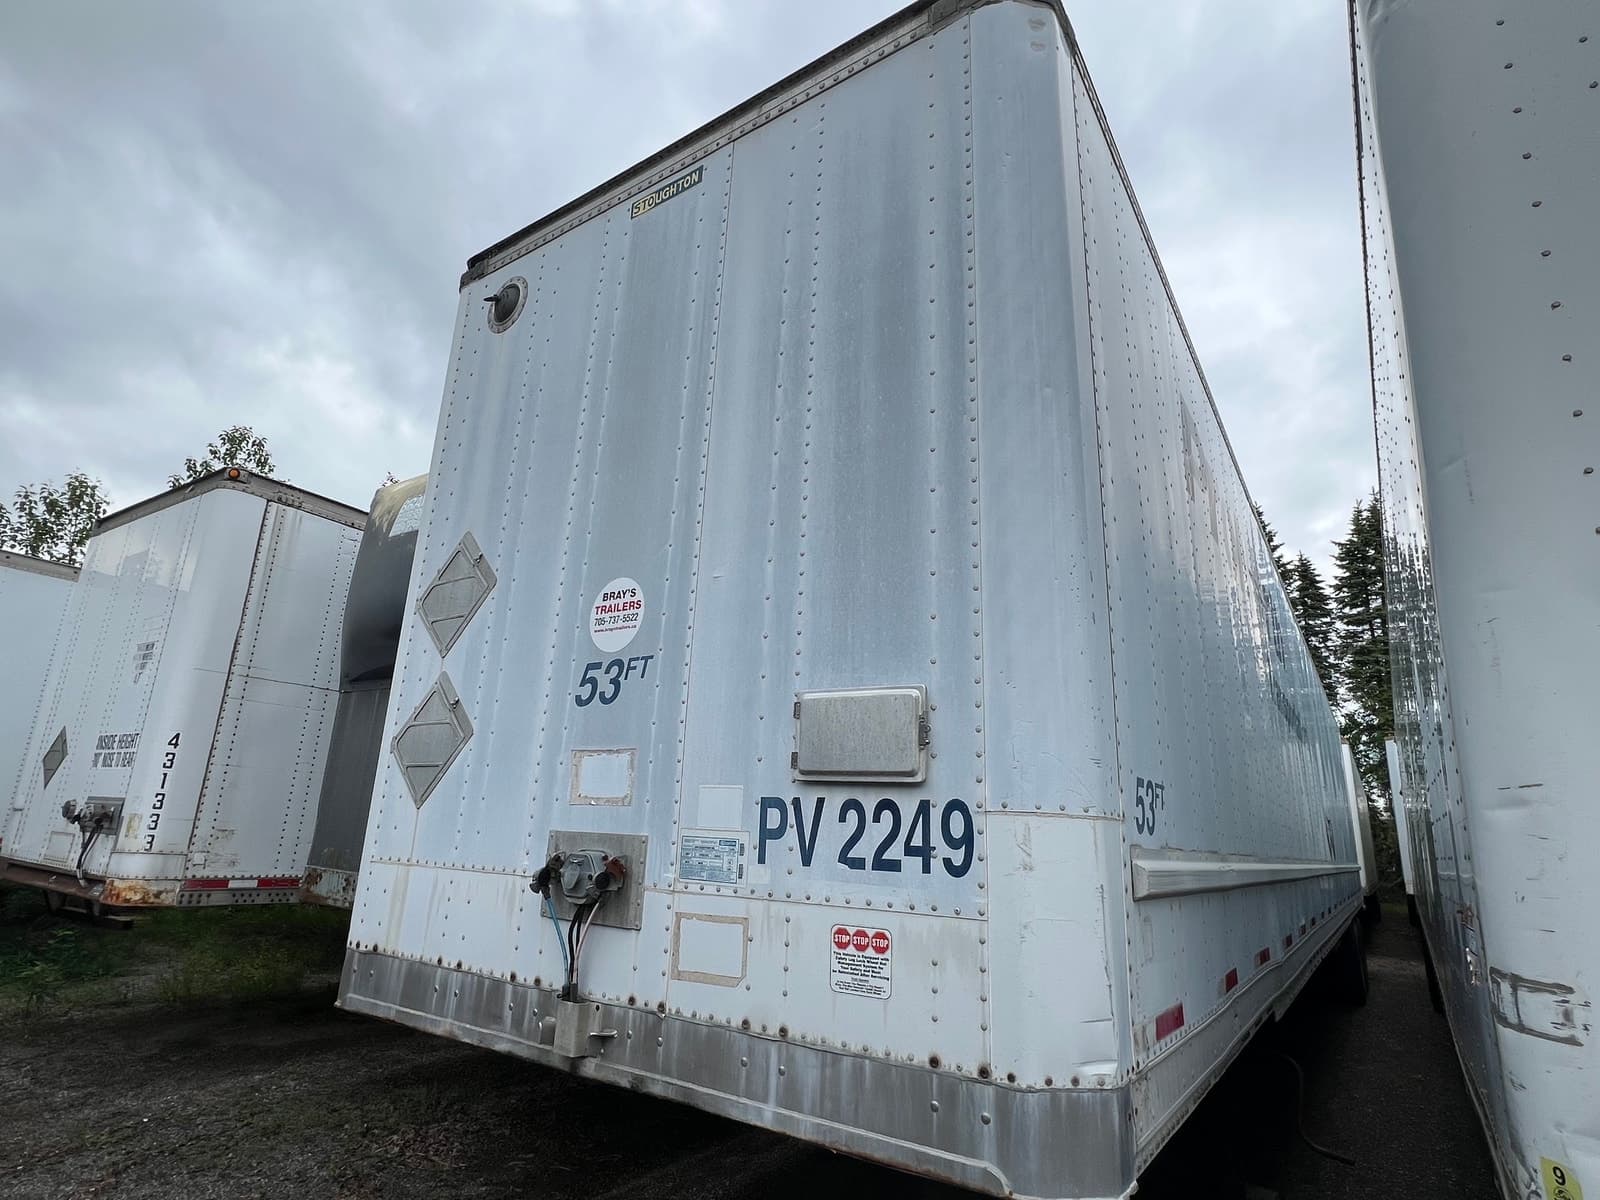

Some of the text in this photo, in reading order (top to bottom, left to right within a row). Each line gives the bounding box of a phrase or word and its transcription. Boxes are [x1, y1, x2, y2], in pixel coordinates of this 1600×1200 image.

[633, 170, 699, 215] STOUGHTON
[602, 588, 637, 602] BRAY'S
[595, 600, 642, 615] TRAILERS
[594, 612, 639, 627] 705-737-5522
[757, 796, 826, 867] PV
[838, 798, 975, 878] 2249
[834, 935, 888, 947] STOP STOP STOP
